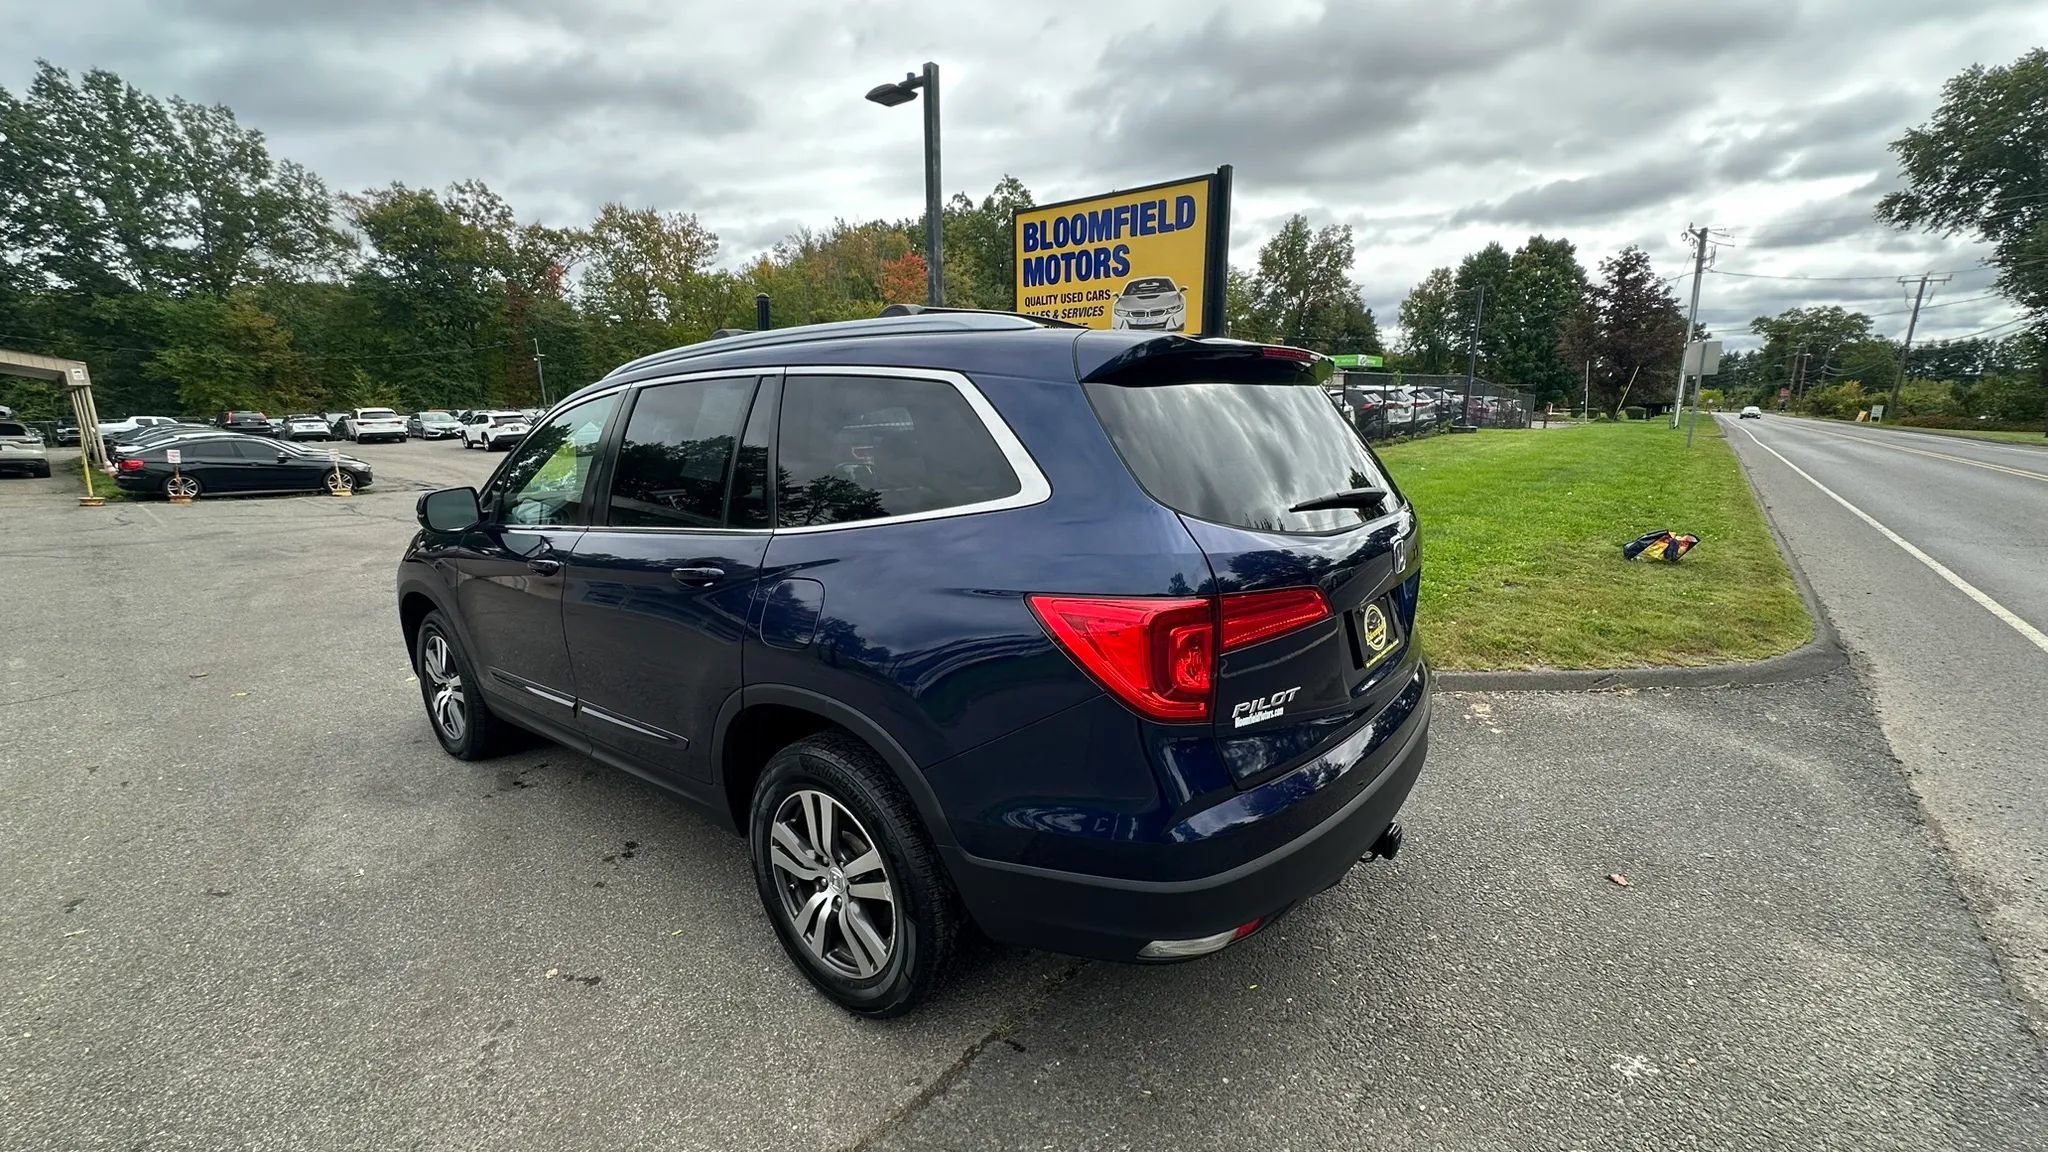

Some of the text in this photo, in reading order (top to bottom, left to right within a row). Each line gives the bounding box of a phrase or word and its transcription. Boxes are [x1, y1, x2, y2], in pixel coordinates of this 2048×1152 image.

[1023, 195, 1196, 252] BLOOMFIELD
[1023, 244, 1131, 287] MOTORS
[1024, 289, 1111, 307] QUALITY USED CARS
[1061, 305, 1104, 319] SERVICES
[1231, 686, 1301, 718] PILOT
